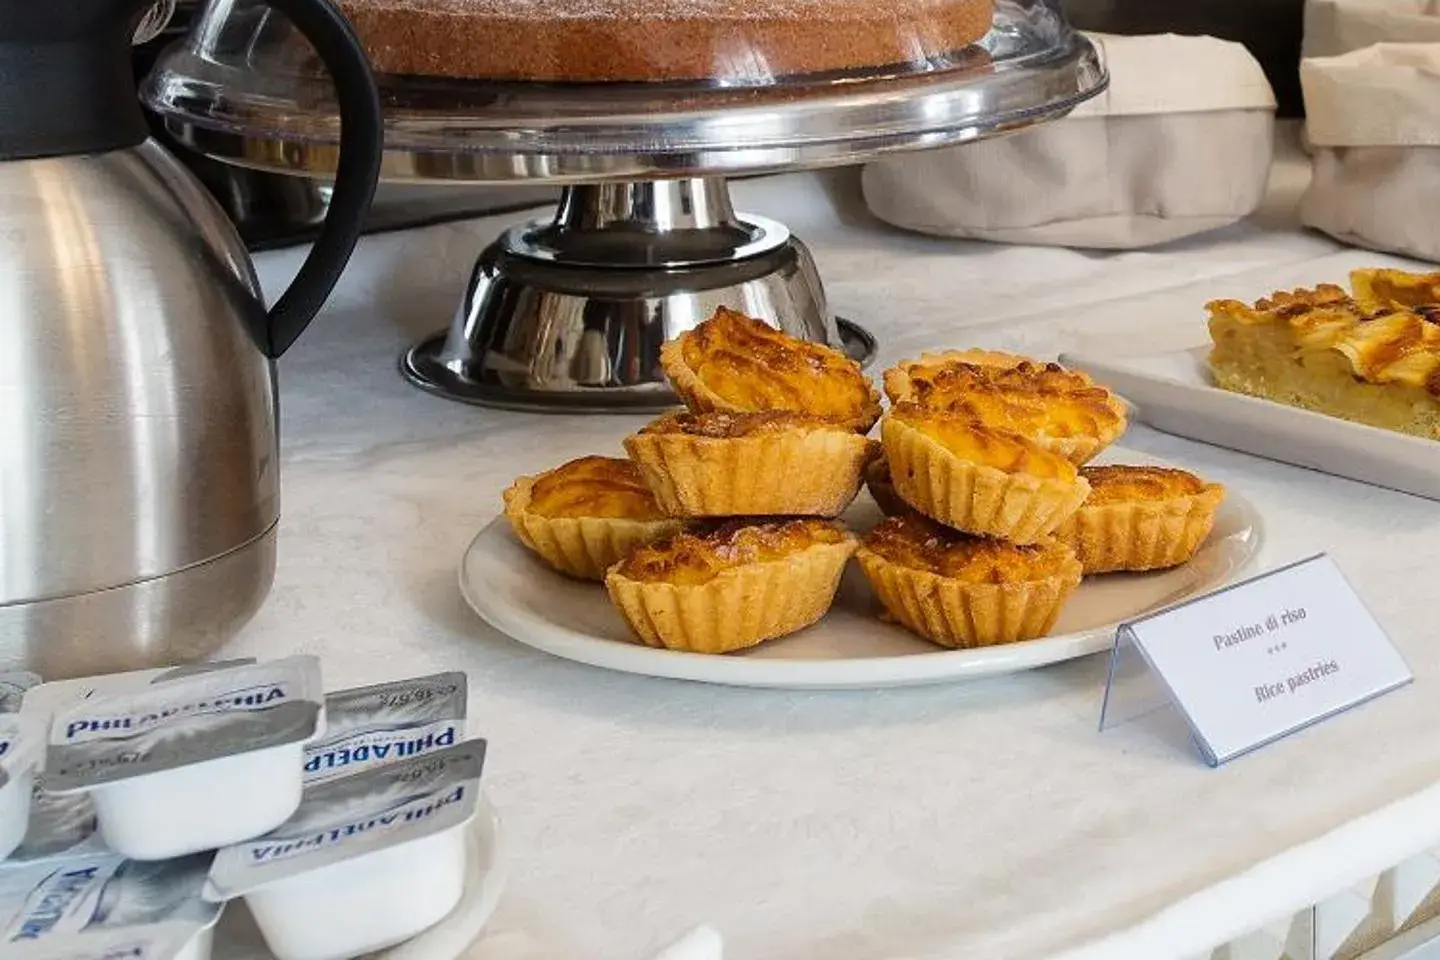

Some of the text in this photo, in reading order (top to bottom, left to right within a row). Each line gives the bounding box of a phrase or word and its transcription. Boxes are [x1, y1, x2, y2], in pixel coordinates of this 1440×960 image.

[1213, 607, 1307, 651] Pastine di riso
[1254, 659, 1340, 703] Rice pastries
[304, 726, 455, 773] PHILADELP
